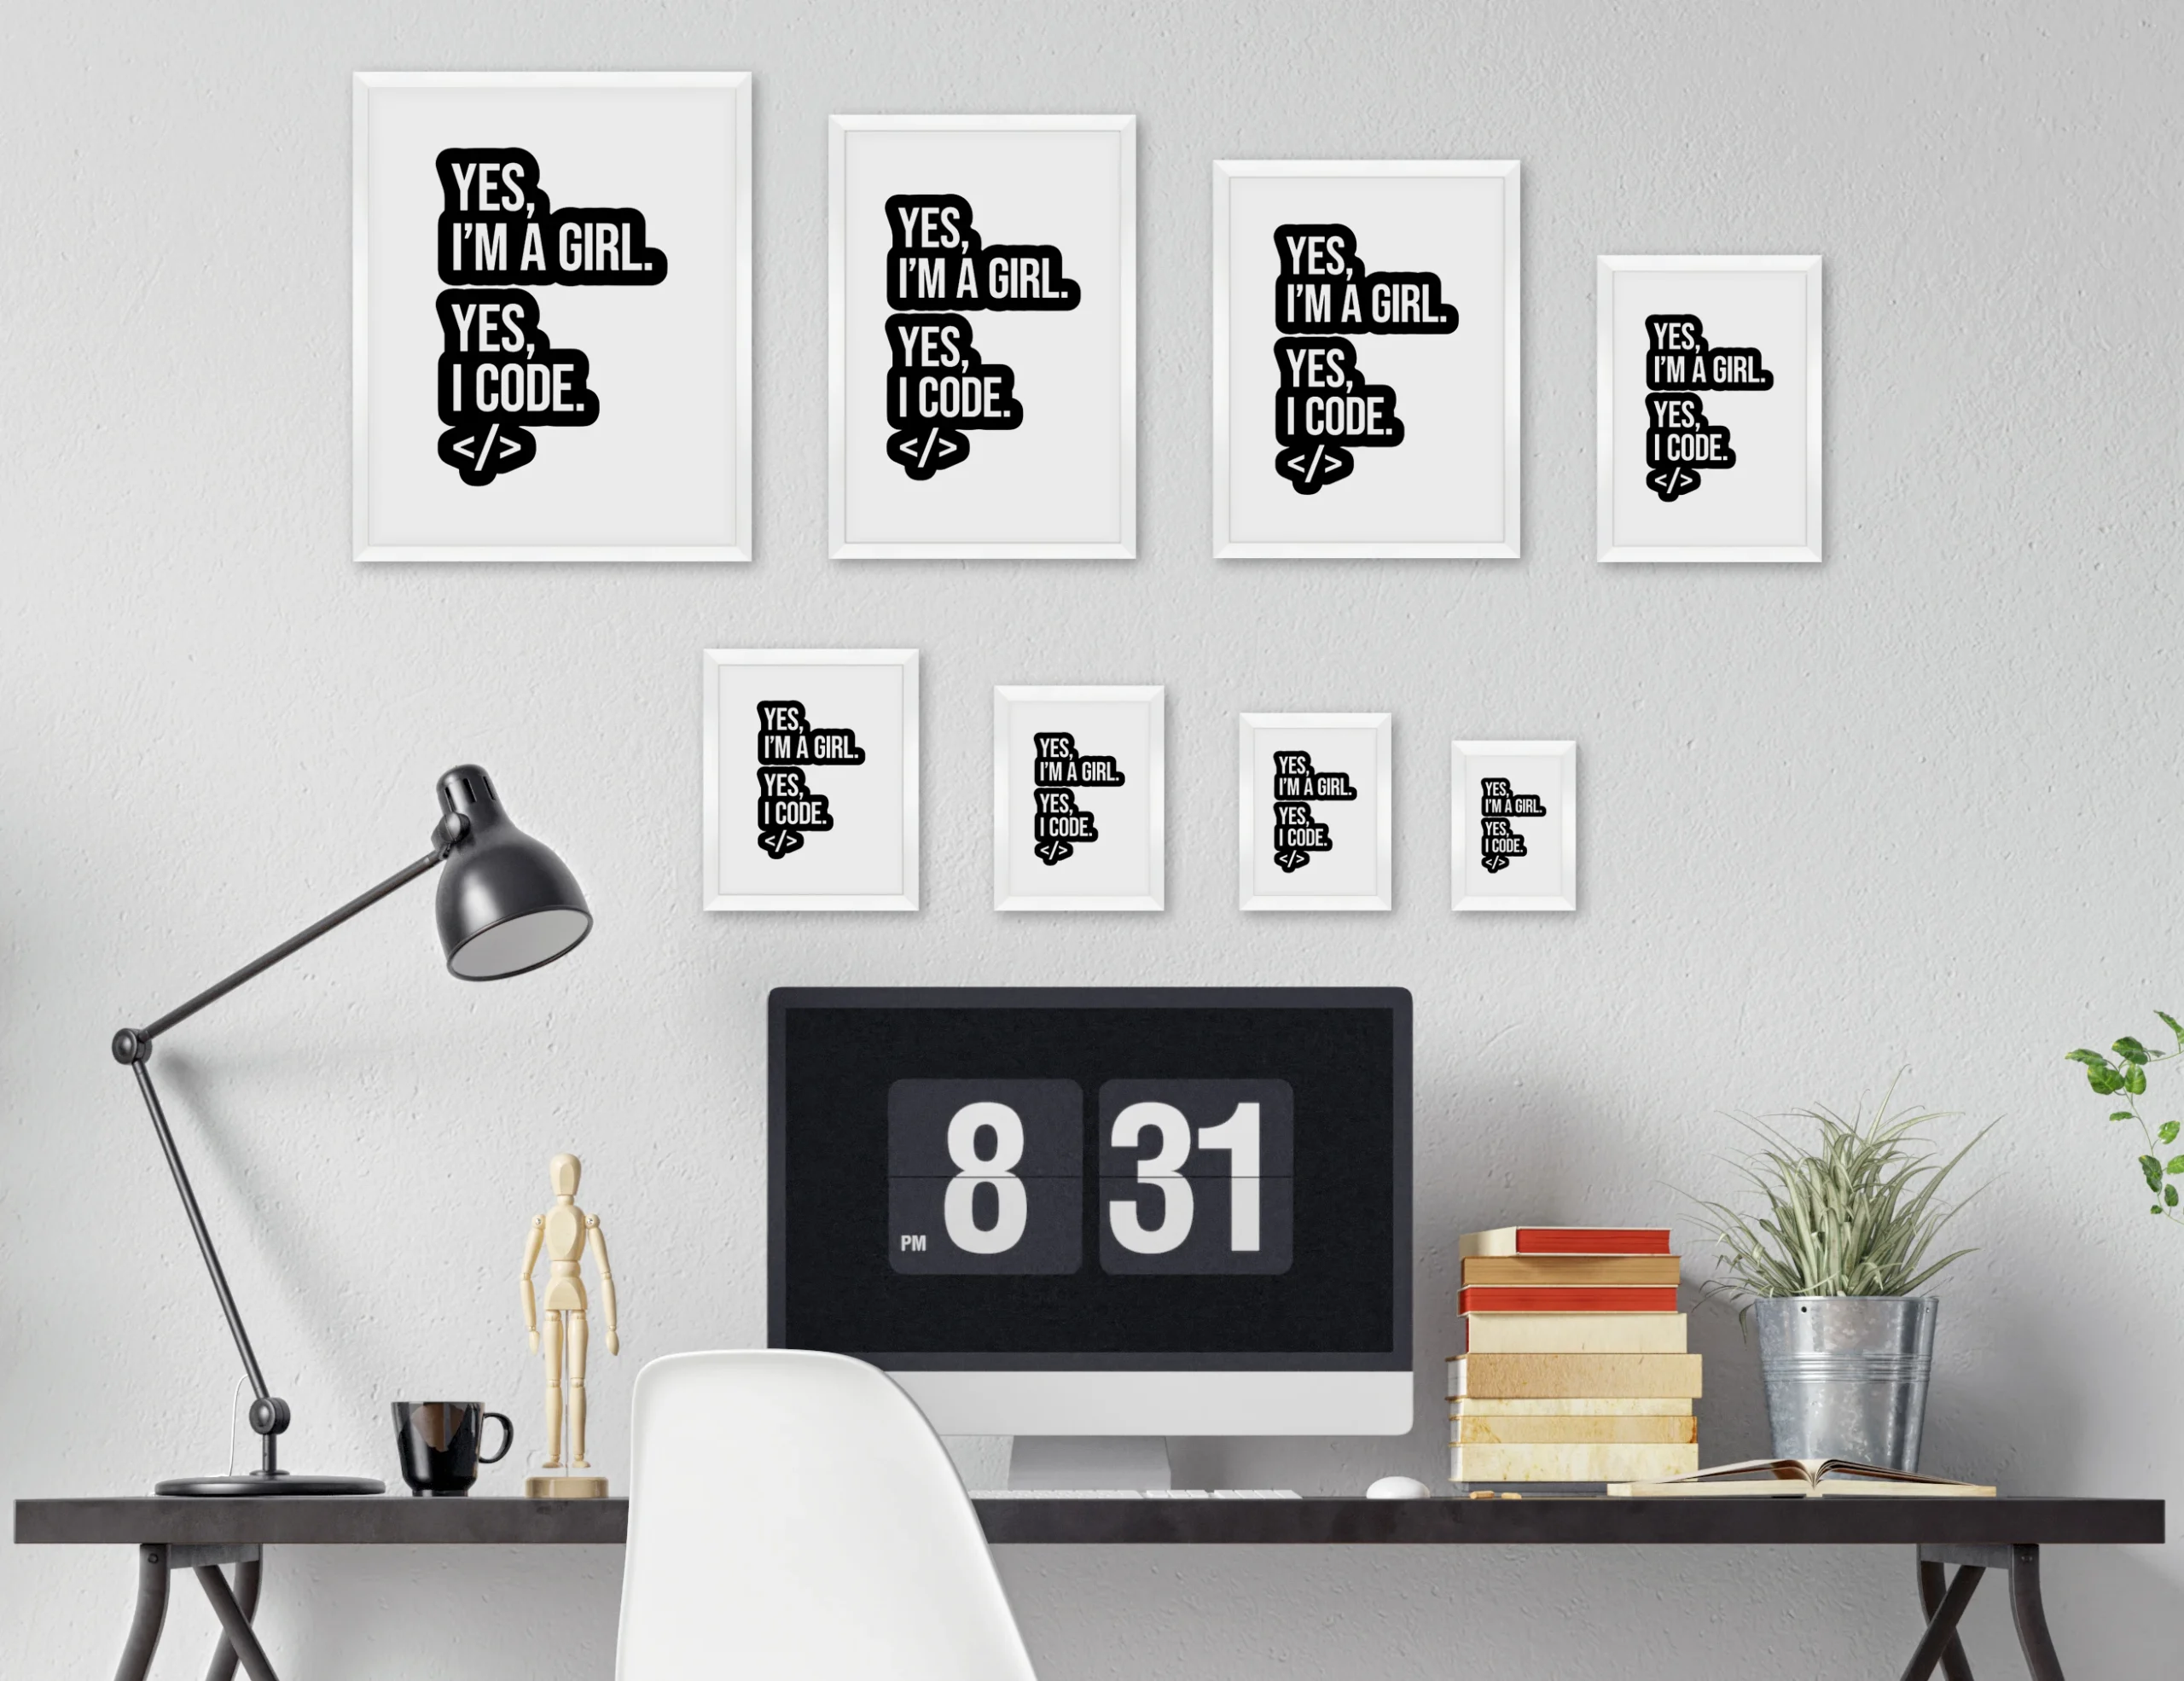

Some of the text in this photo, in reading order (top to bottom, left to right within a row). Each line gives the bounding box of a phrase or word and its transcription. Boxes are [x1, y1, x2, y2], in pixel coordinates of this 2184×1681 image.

[450, 162, 535, 219] YES,
[897, 206, 969, 255] YES,
[453, 222, 653, 271] I'M A GIRL.
[1286, 236, 1353, 282] YES,
[899, 257, 1068, 300] I'M A GIRL.
[1287, 283, 1447, 323] I'M A GIRL.
[450, 303, 535, 360] YES,
[1653, 322, 1700, 354] YES,
[897, 325, 969, 374] YES,
[1286, 348, 1353, 394] YES,
[1654, 355, 1766, 383] I'M A GIRL.
[453, 363, 584, 412] I CODE.
[899, 375, 1011, 418] I CODE.
[1287, 396, 1393, 436] I CODE.
[1653, 400, 1700, 433] YES,
[1654, 433, 1728, 462] I CODE.
[764, 707, 804, 735] YES,
[764, 735, 859, 759] I'M A GIRL.
[1039, 737, 1073, 761] YES,
[1040, 761, 1119, 782] I'M A GIRL.
[1278, 755, 1310, 777] YES,
[764, 773, 804, 800] YES,
[1279, 777, 1352, 796] I'M A GIRL.
[1484, 781, 1509, 799] YES,
[764, 800, 827, 825] I CODE.
[1039, 793, 1073, 817] YES,
[1279, 806, 1310, 828] YES,
[1485, 798, 1543, 813] I'M A GIRL.
[1040, 817, 1093, 837] I CODE.
[1279, 828, 1327, 846] I CODE.
[1484, 821, 1510, 838] YES,
[1485, 838, 1524, 853] I CODE.
[944, 1102, 1260, 1254] 8 31
[901, 1235, 926, 1252] PM
